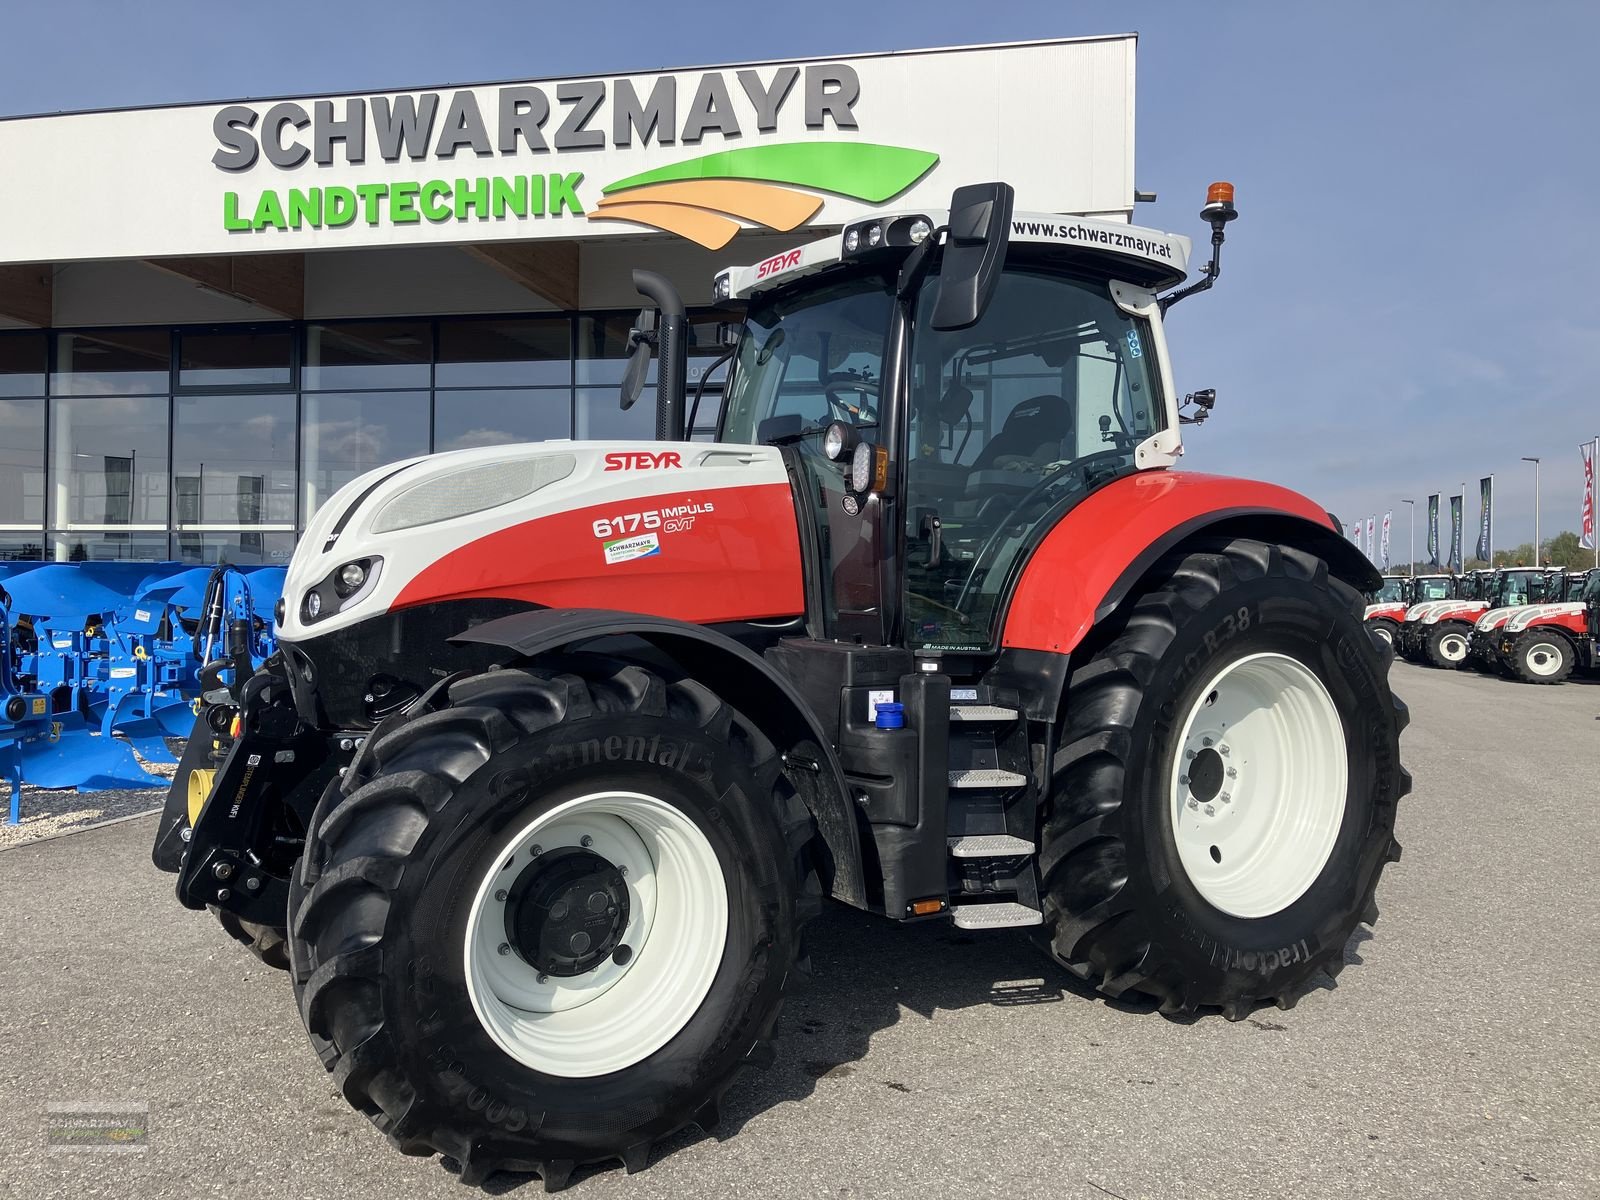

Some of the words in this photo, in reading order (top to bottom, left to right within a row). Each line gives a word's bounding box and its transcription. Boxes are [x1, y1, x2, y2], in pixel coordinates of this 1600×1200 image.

[211, 63, 861, 171] SCHWARZMAYR
[223, 172, 587, 233] LANDTECHNIK
[1012, 221, 1172, 258] www.schwarzmayr.at
[757, 249, 802, 279] STEYR
[604, 451, 682, 471] STEYR
[592, 510, 661, 538] 6175
[661, 503, 715, 518] IMPULS
[664, 517, 695, 533] CVT
[609, 540, 651, 552] SCHWARZMAYR
